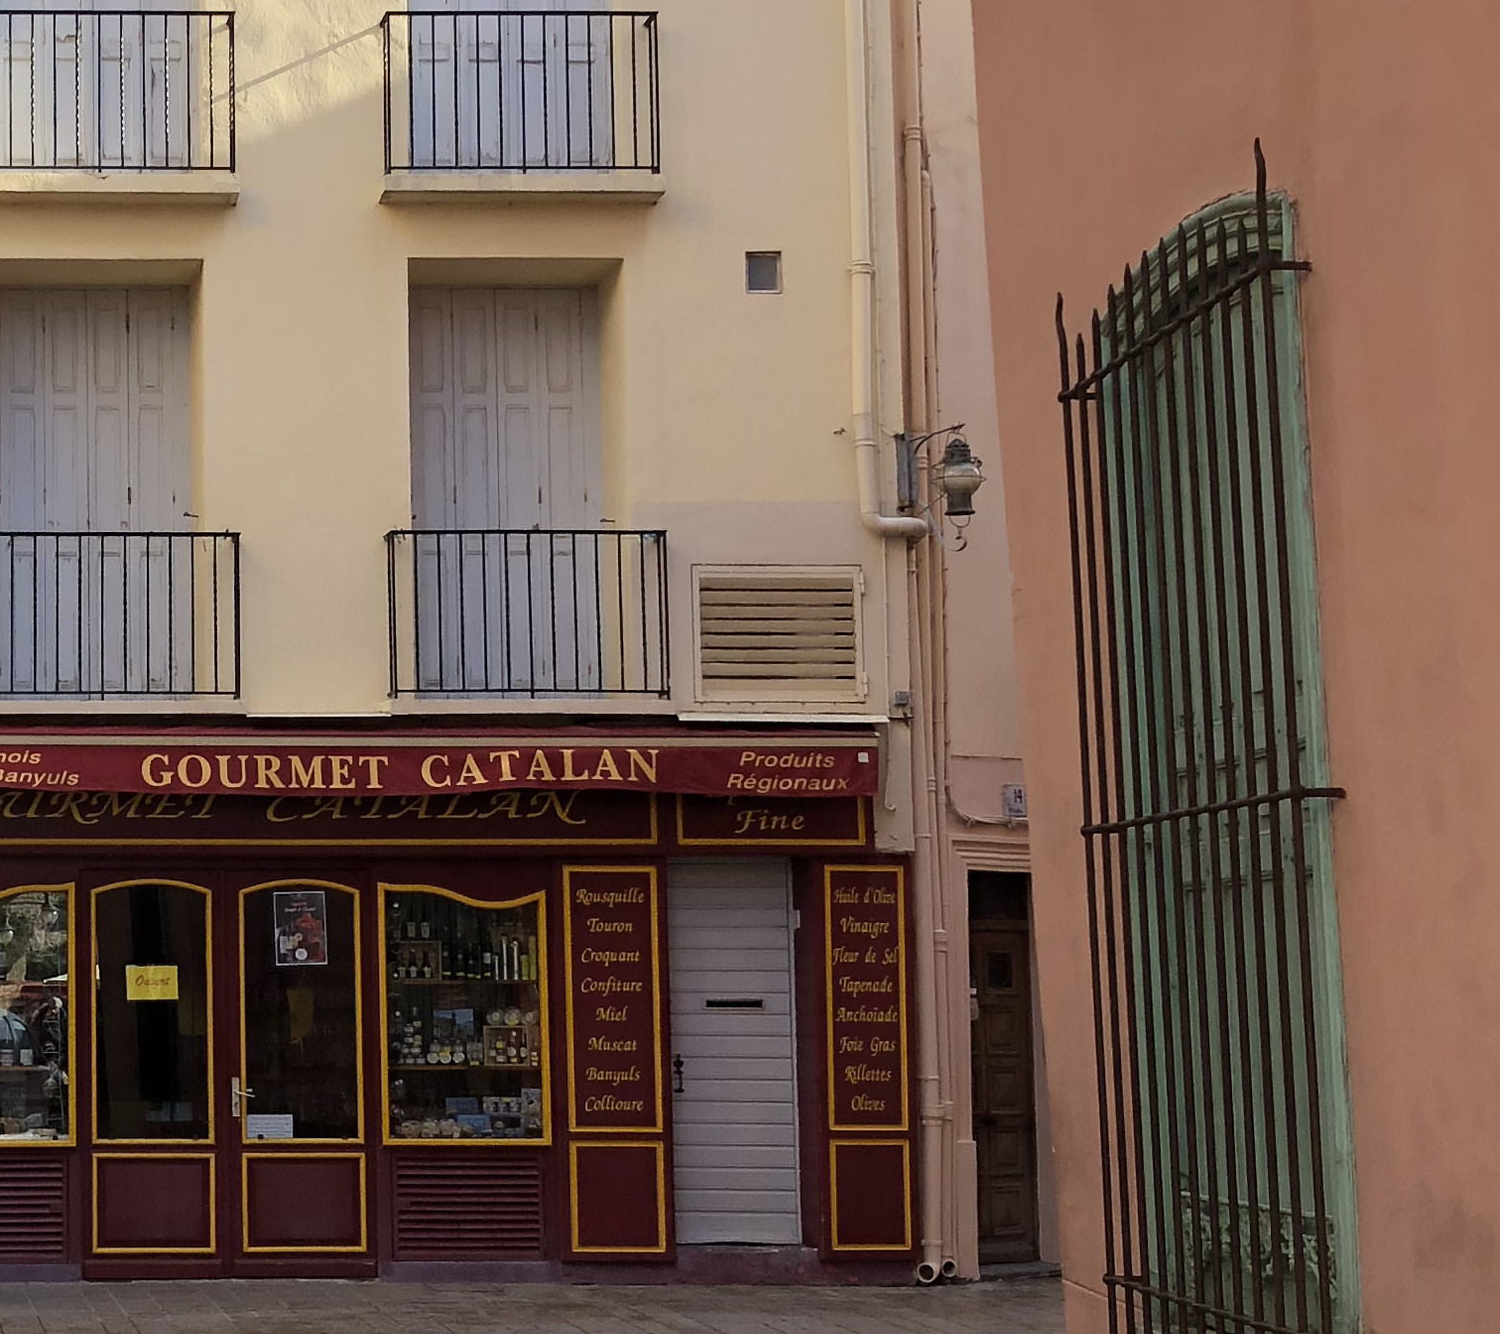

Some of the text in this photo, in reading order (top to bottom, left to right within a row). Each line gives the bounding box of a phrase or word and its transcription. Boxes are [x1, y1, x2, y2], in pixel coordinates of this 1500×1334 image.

[141, 748, 659, 789] GOURMET CATALAN
[740, 751, 835, 769] Produits
[727, 772, 850, 793] Régionaux
[266, 790, 586, 824] CATALAN
[734, 809, 805, 834] Fine
[576, 888, 644, 908] Rousquille
[587, 918, 633, 932] Touron
[840, 916, 890, 939] Vinaigre
[581, 948, 640, 967] Croquant
[832, 946, 898, 965] Fleur de Sel
[580, 977, 643, 997] Confiture
[839, 976, 893, 998] Tapenade
[596, 1006, 628, 1021] Miel
[588, 1037, 638, 1052] Muscat
[870, 1037, 896, 1057] Gras
[586, 1066, 641, 1086] Banyuls
[845, 1064, 892, 1084] Rillettes
[585, 1096, 644, 1112] Collioure
[851, 1096, 886, 1111] Olives
